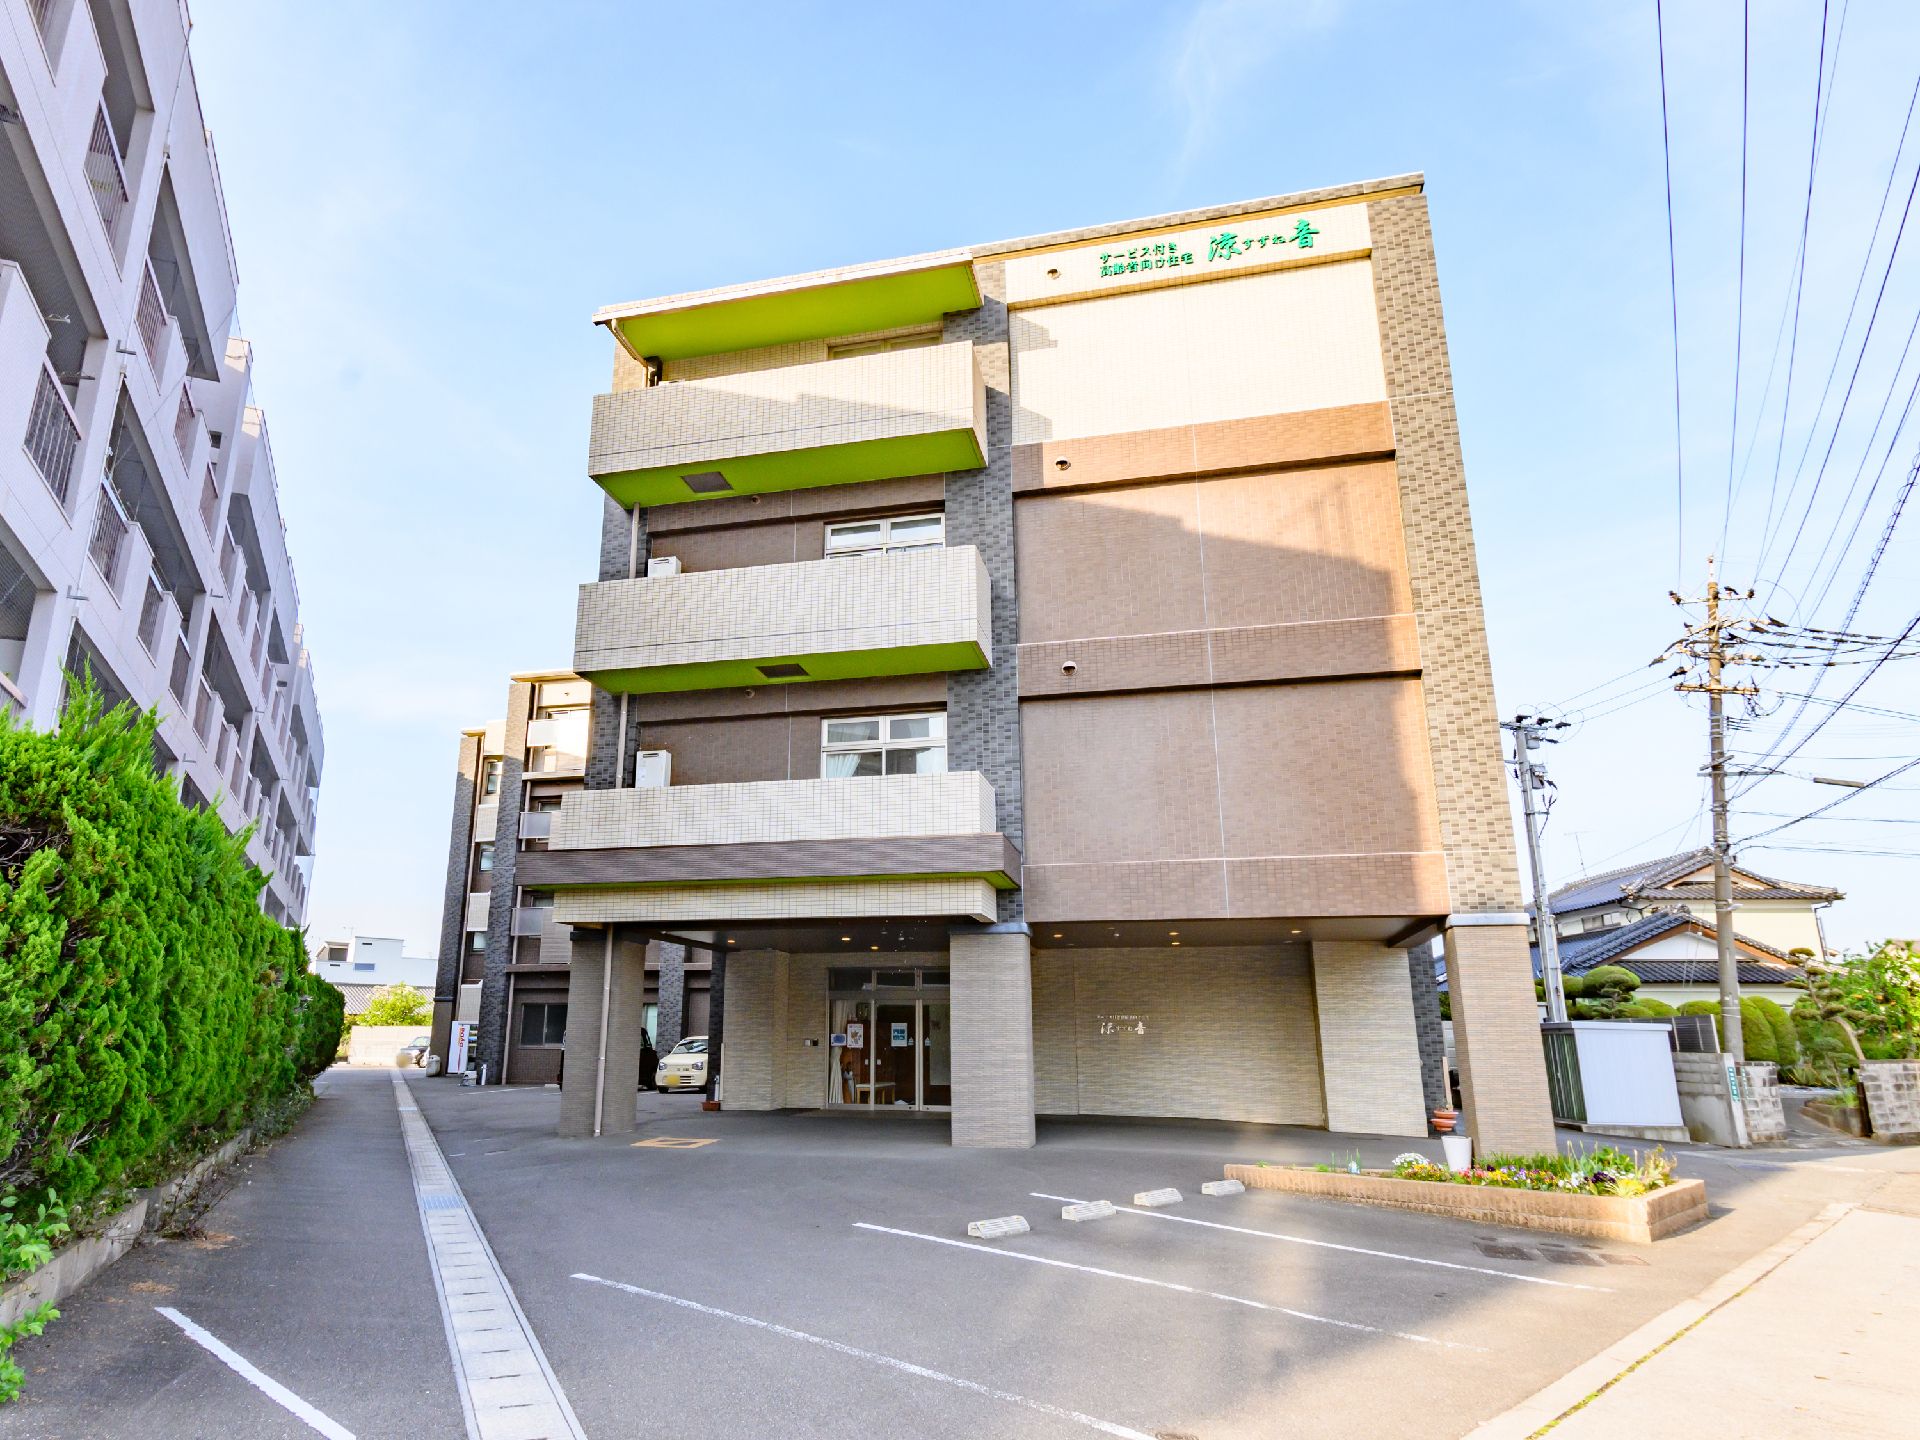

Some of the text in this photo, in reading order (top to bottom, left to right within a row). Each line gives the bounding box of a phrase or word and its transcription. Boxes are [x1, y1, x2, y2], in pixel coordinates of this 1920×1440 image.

[1100, 242, 1177, 264] サービス付き
[1100, 252, 1194, 278] 高齢者向け住宅
